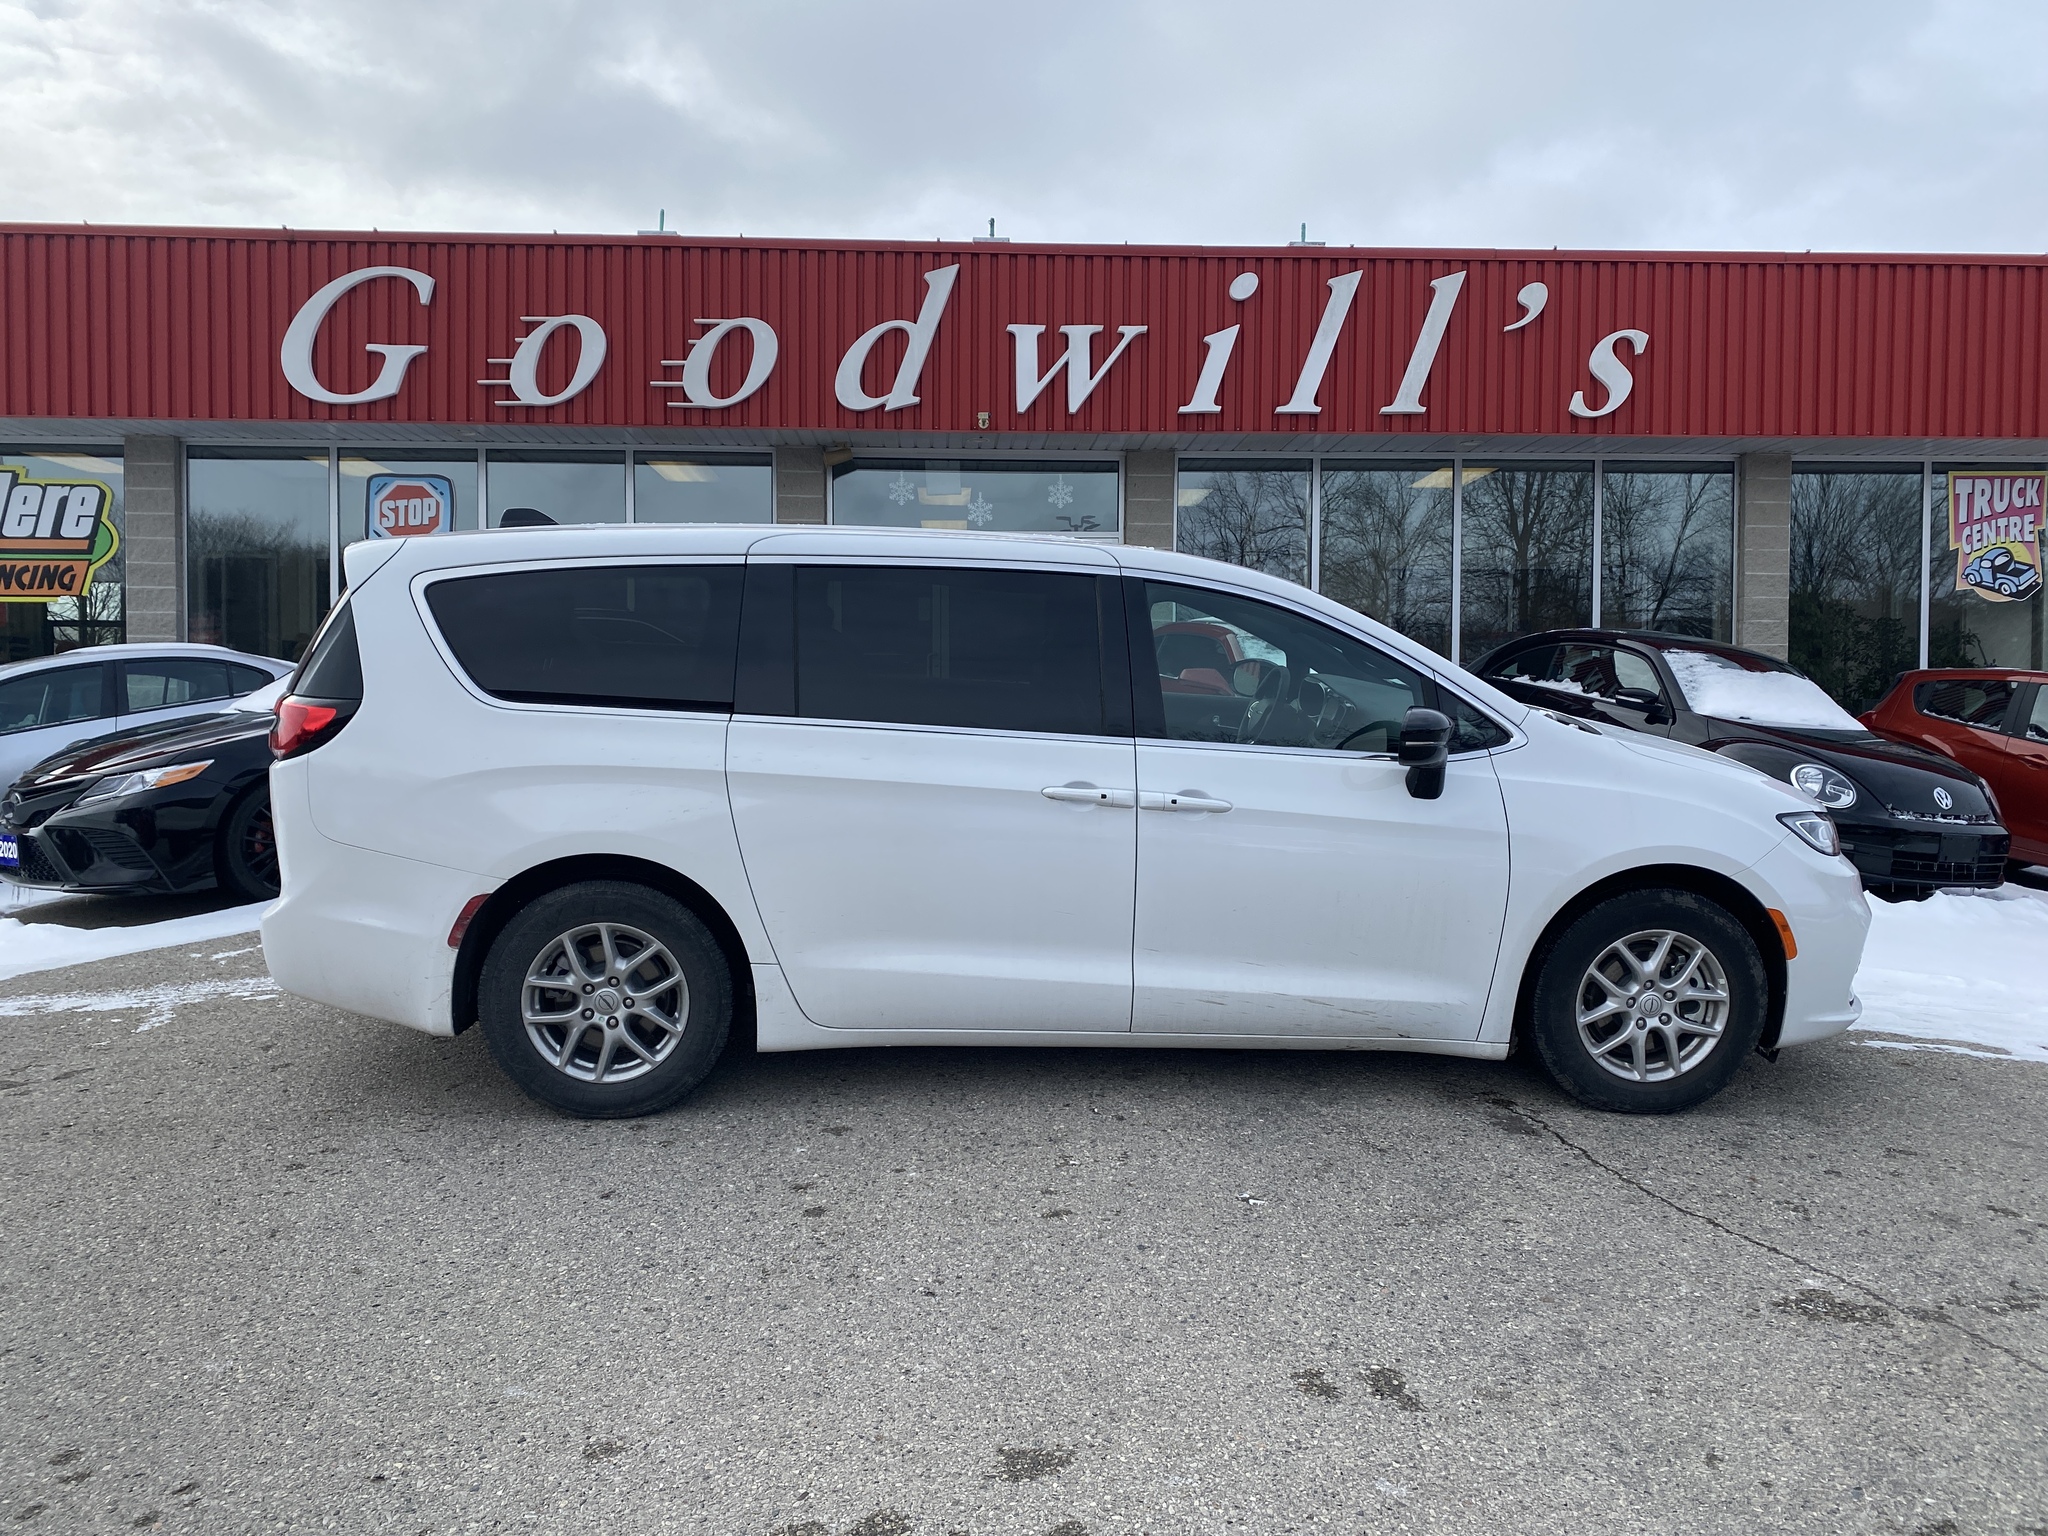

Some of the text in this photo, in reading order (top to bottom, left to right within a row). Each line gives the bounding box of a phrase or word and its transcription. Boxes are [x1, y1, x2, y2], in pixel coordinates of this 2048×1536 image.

[279, 263, 1650, 419] Goodwill's
[380, 497, 437, 528] STOP
[1955, 478, 2041, 524] TRUCK
[1961, 513, 2035, 555] CENTRE
